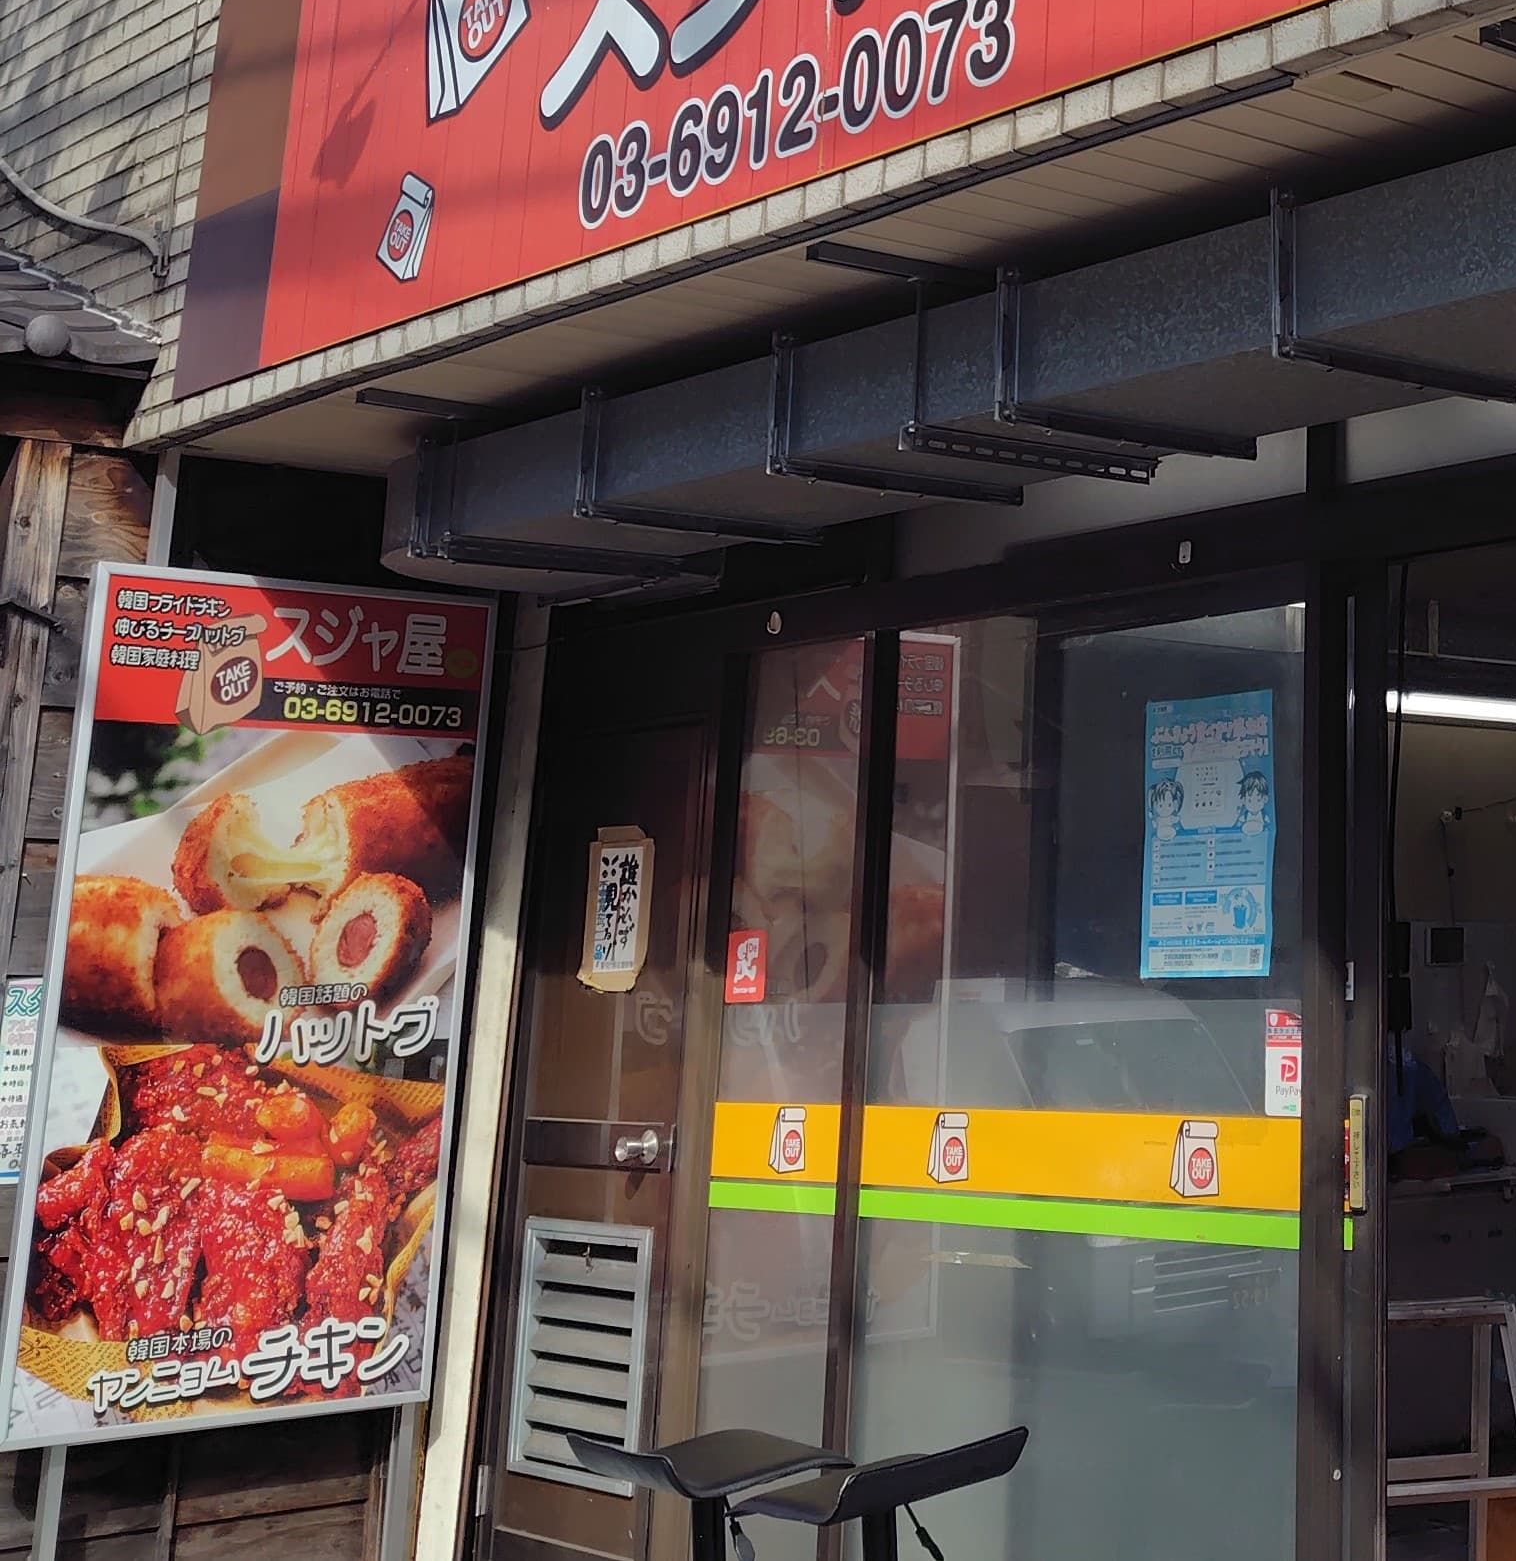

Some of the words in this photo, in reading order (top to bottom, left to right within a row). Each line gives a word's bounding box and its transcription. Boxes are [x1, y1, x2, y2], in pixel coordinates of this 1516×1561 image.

[395, 218, 411, 236] TAKE
[390, 232, 408, 253] OUT
[117, 589, 231, 618] 韓国フライドチキン
[265, 605, 447, 677] スジャ屋
[109, 643, 200, 672] 韓国家庭料理
[216, 663, 251, 687] TAKE
[220, 678, 251, 703] OUT
[284, 695, 463, 727] 03-6912-0073
[279, 983, 367, 1007] 韓国話題の
[255, 996, 440, 1066] ハットグ
[785, 1138, 801, 1148] TAKE
[785, 1147, 800, 1158] OUT
[945, 1146, 963, 1156] TAKE
[946, 1156, 962, 1167] OUT
[1191, 1157, 1212, 1169] TAKE
[1191, 1168, 1211, 1180] OUT
[127, 1326, 233, 1363] 韓国本場の
